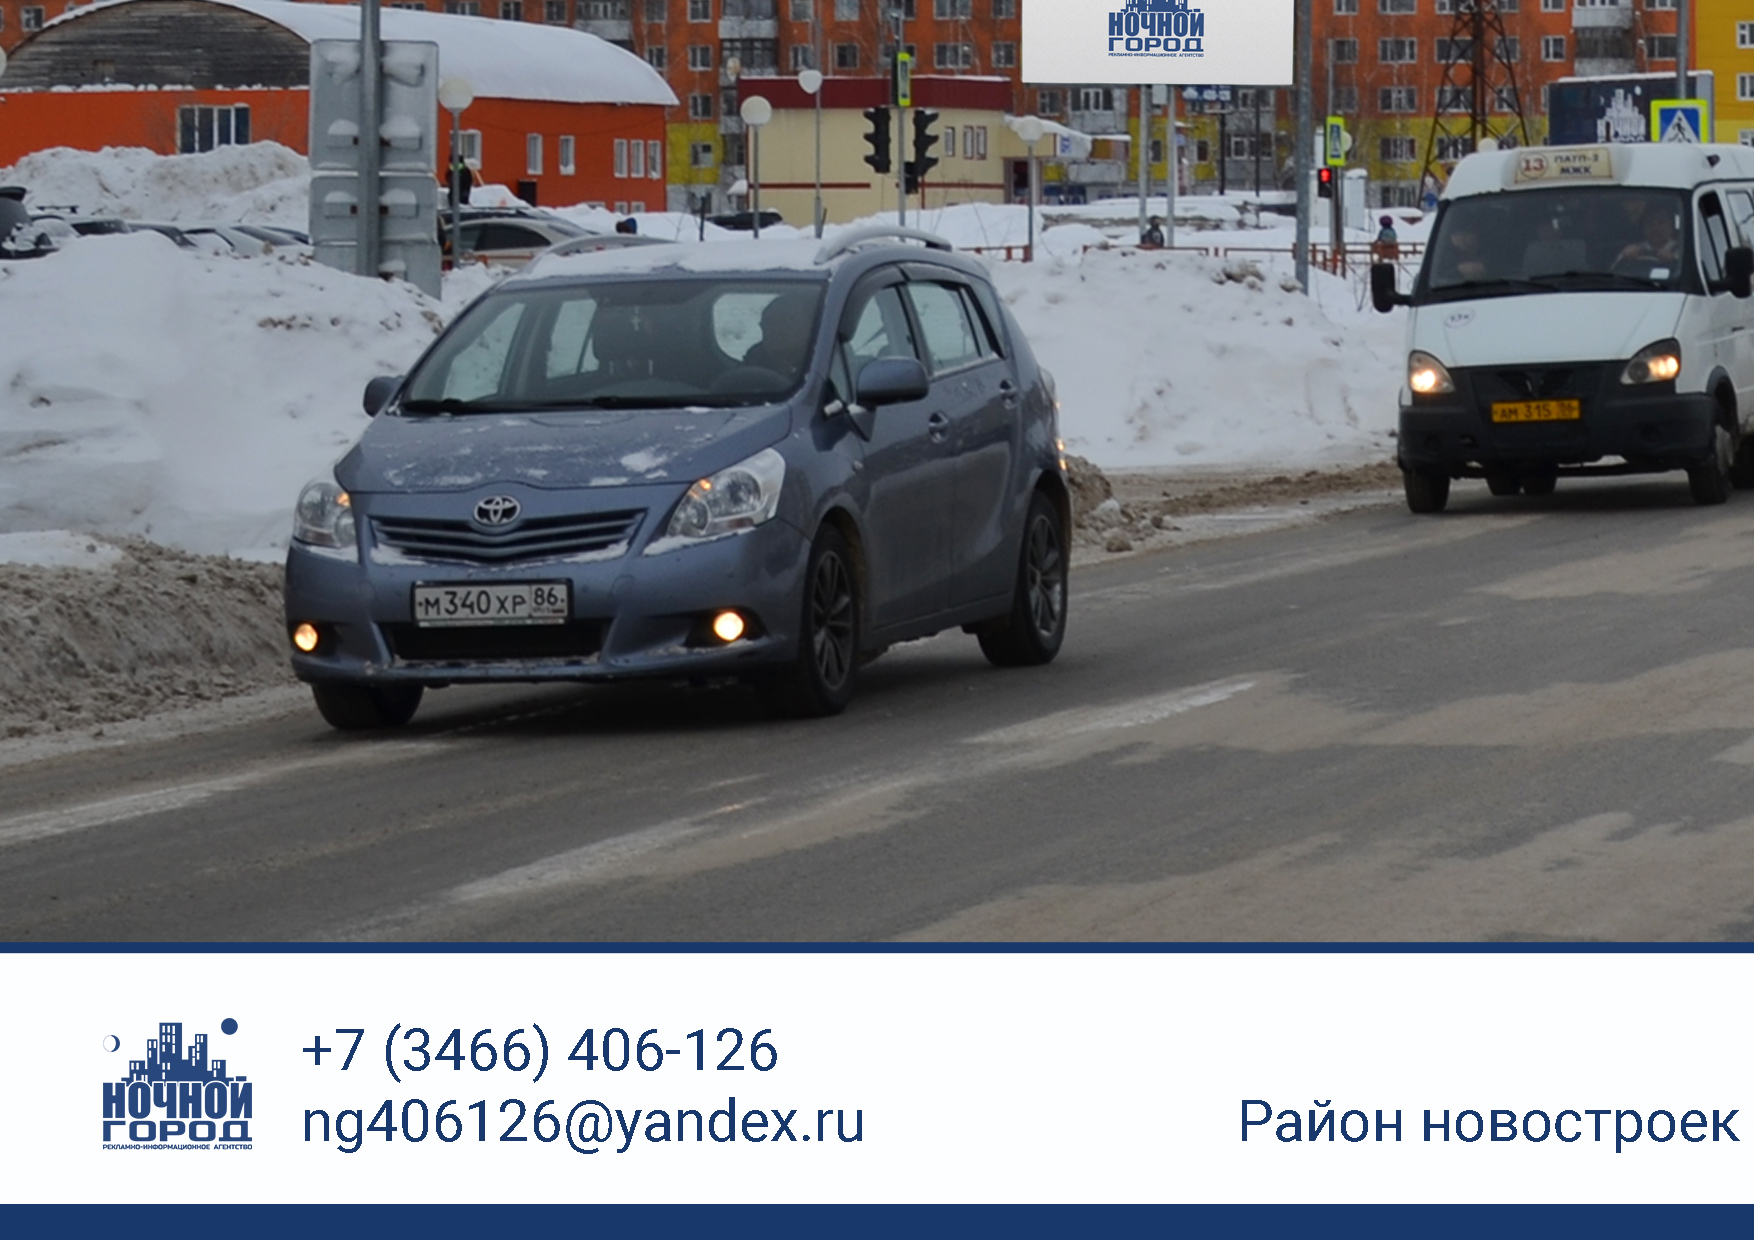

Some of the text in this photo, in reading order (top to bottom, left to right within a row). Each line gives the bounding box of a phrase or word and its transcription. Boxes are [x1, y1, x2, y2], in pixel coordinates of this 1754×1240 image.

[1108, 8, 1205, 37] НОЧНОЙ
[1108, 37, 1205, 53] ГОРОД
[1523, 157, 1545, 172] 13
[1560, 165, 1592, 175] МЖК
[1524, 402, 1552, 418] 315
[533, 587, 559, 607] 86
